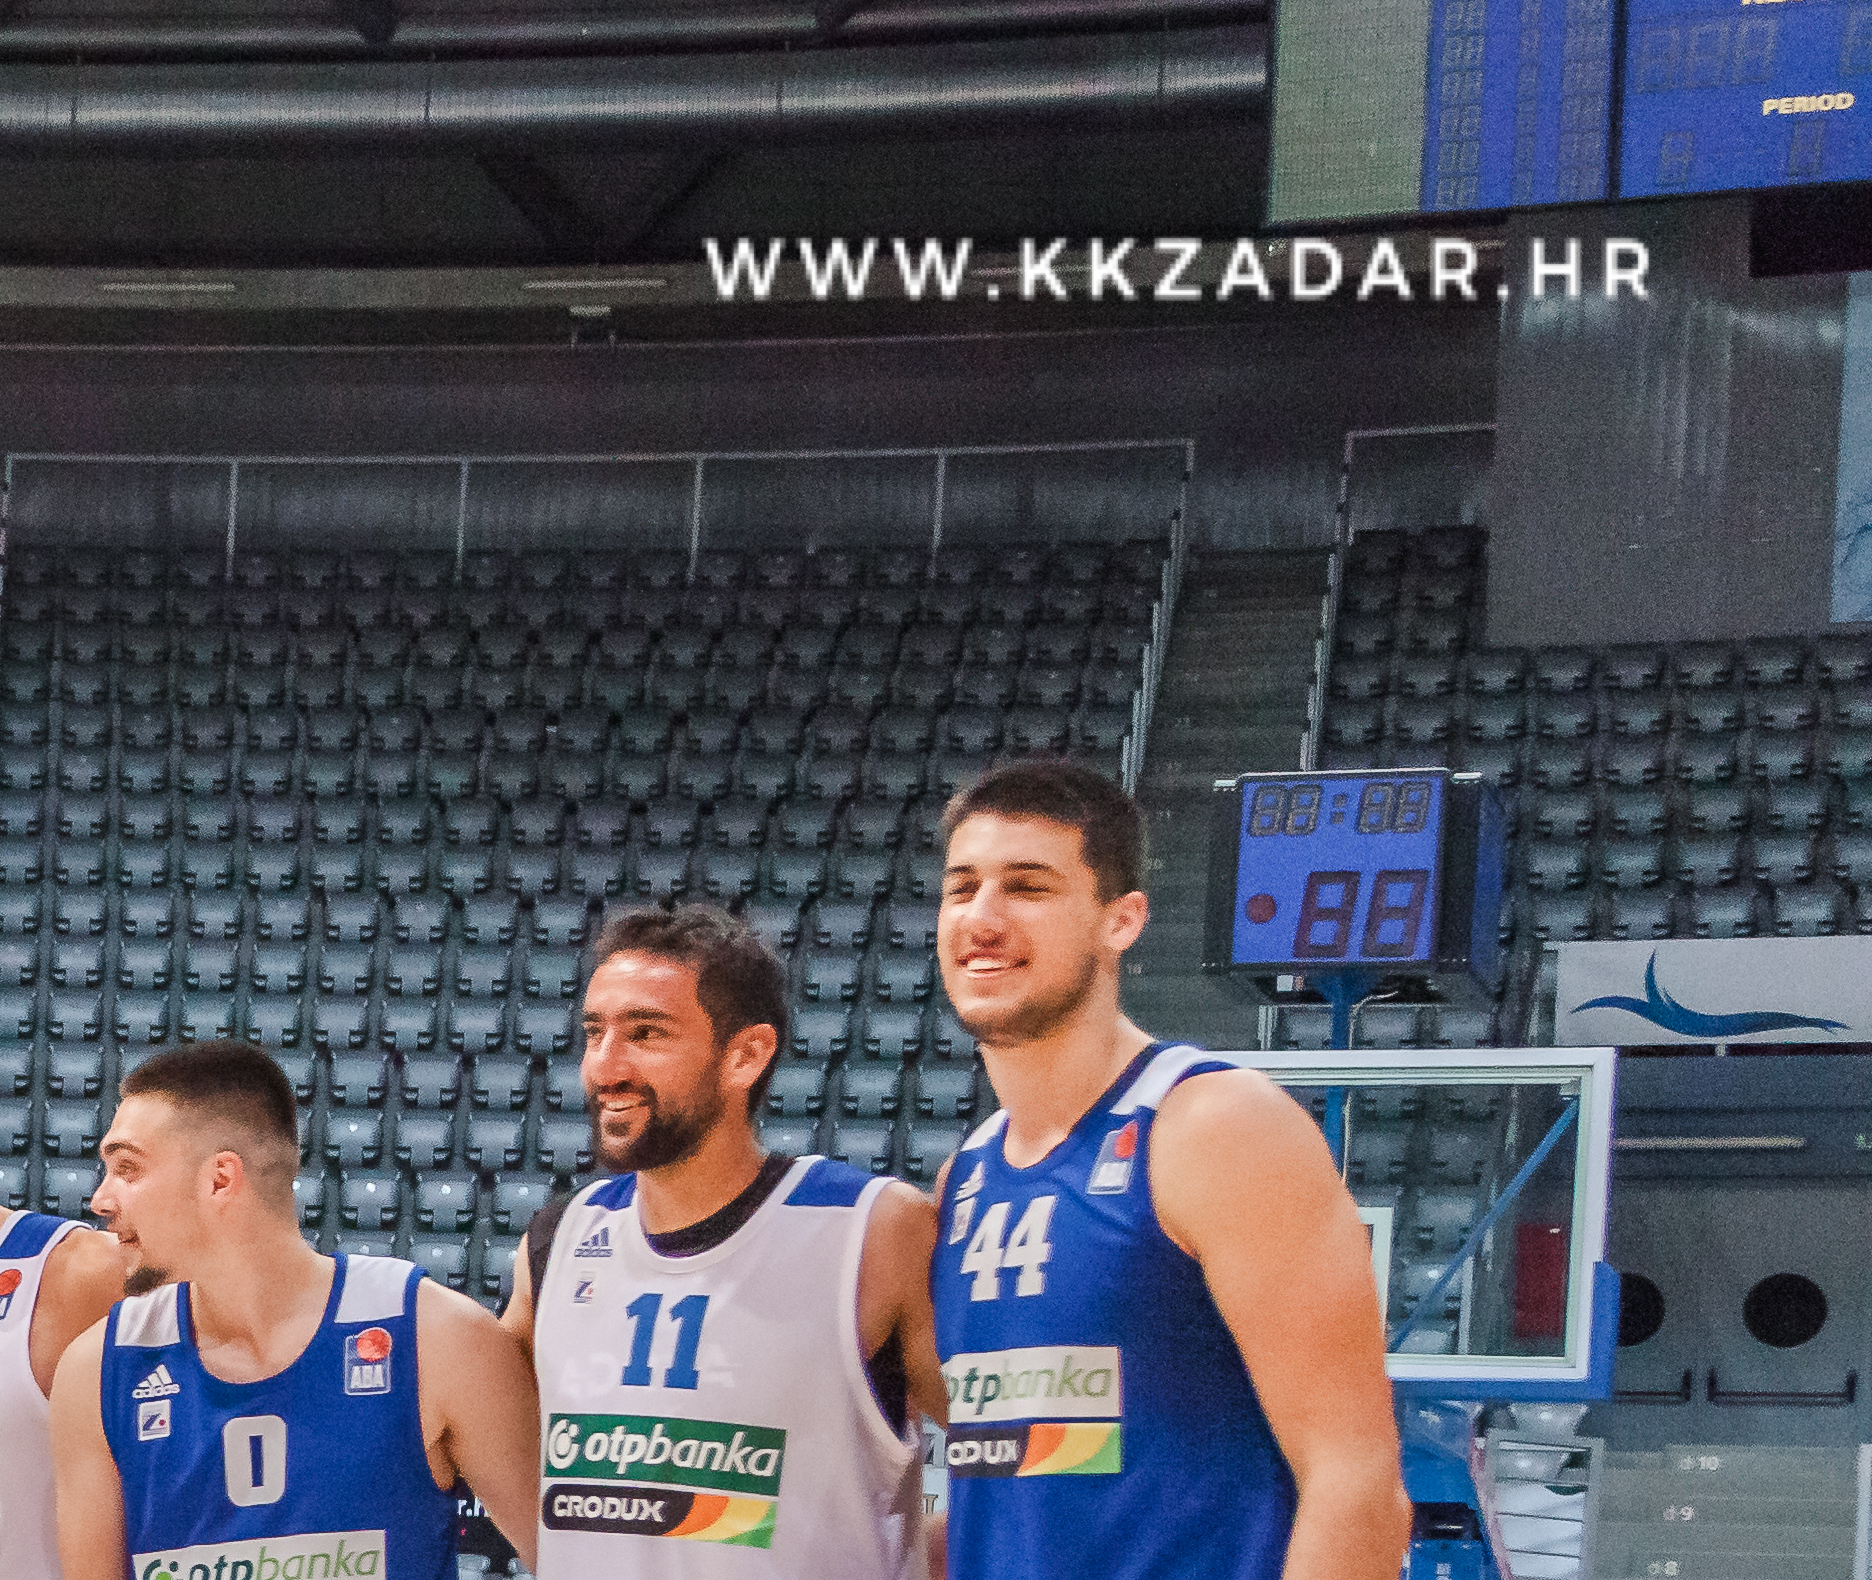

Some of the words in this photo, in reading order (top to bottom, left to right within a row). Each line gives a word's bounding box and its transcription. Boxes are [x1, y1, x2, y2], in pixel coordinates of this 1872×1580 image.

[1762, 92, 1856, 116] PERIOD
[960, 1195, 1058, 1302] 44
[620, 1292, 711, 1391] 11
[222, 1413, 288, 1508] 0
[584, 1423, 780, 1478] otpbanka
[946, 1440, 1019, 1466] ODUX
[552, 1494, 666, 1524] CRODUX
